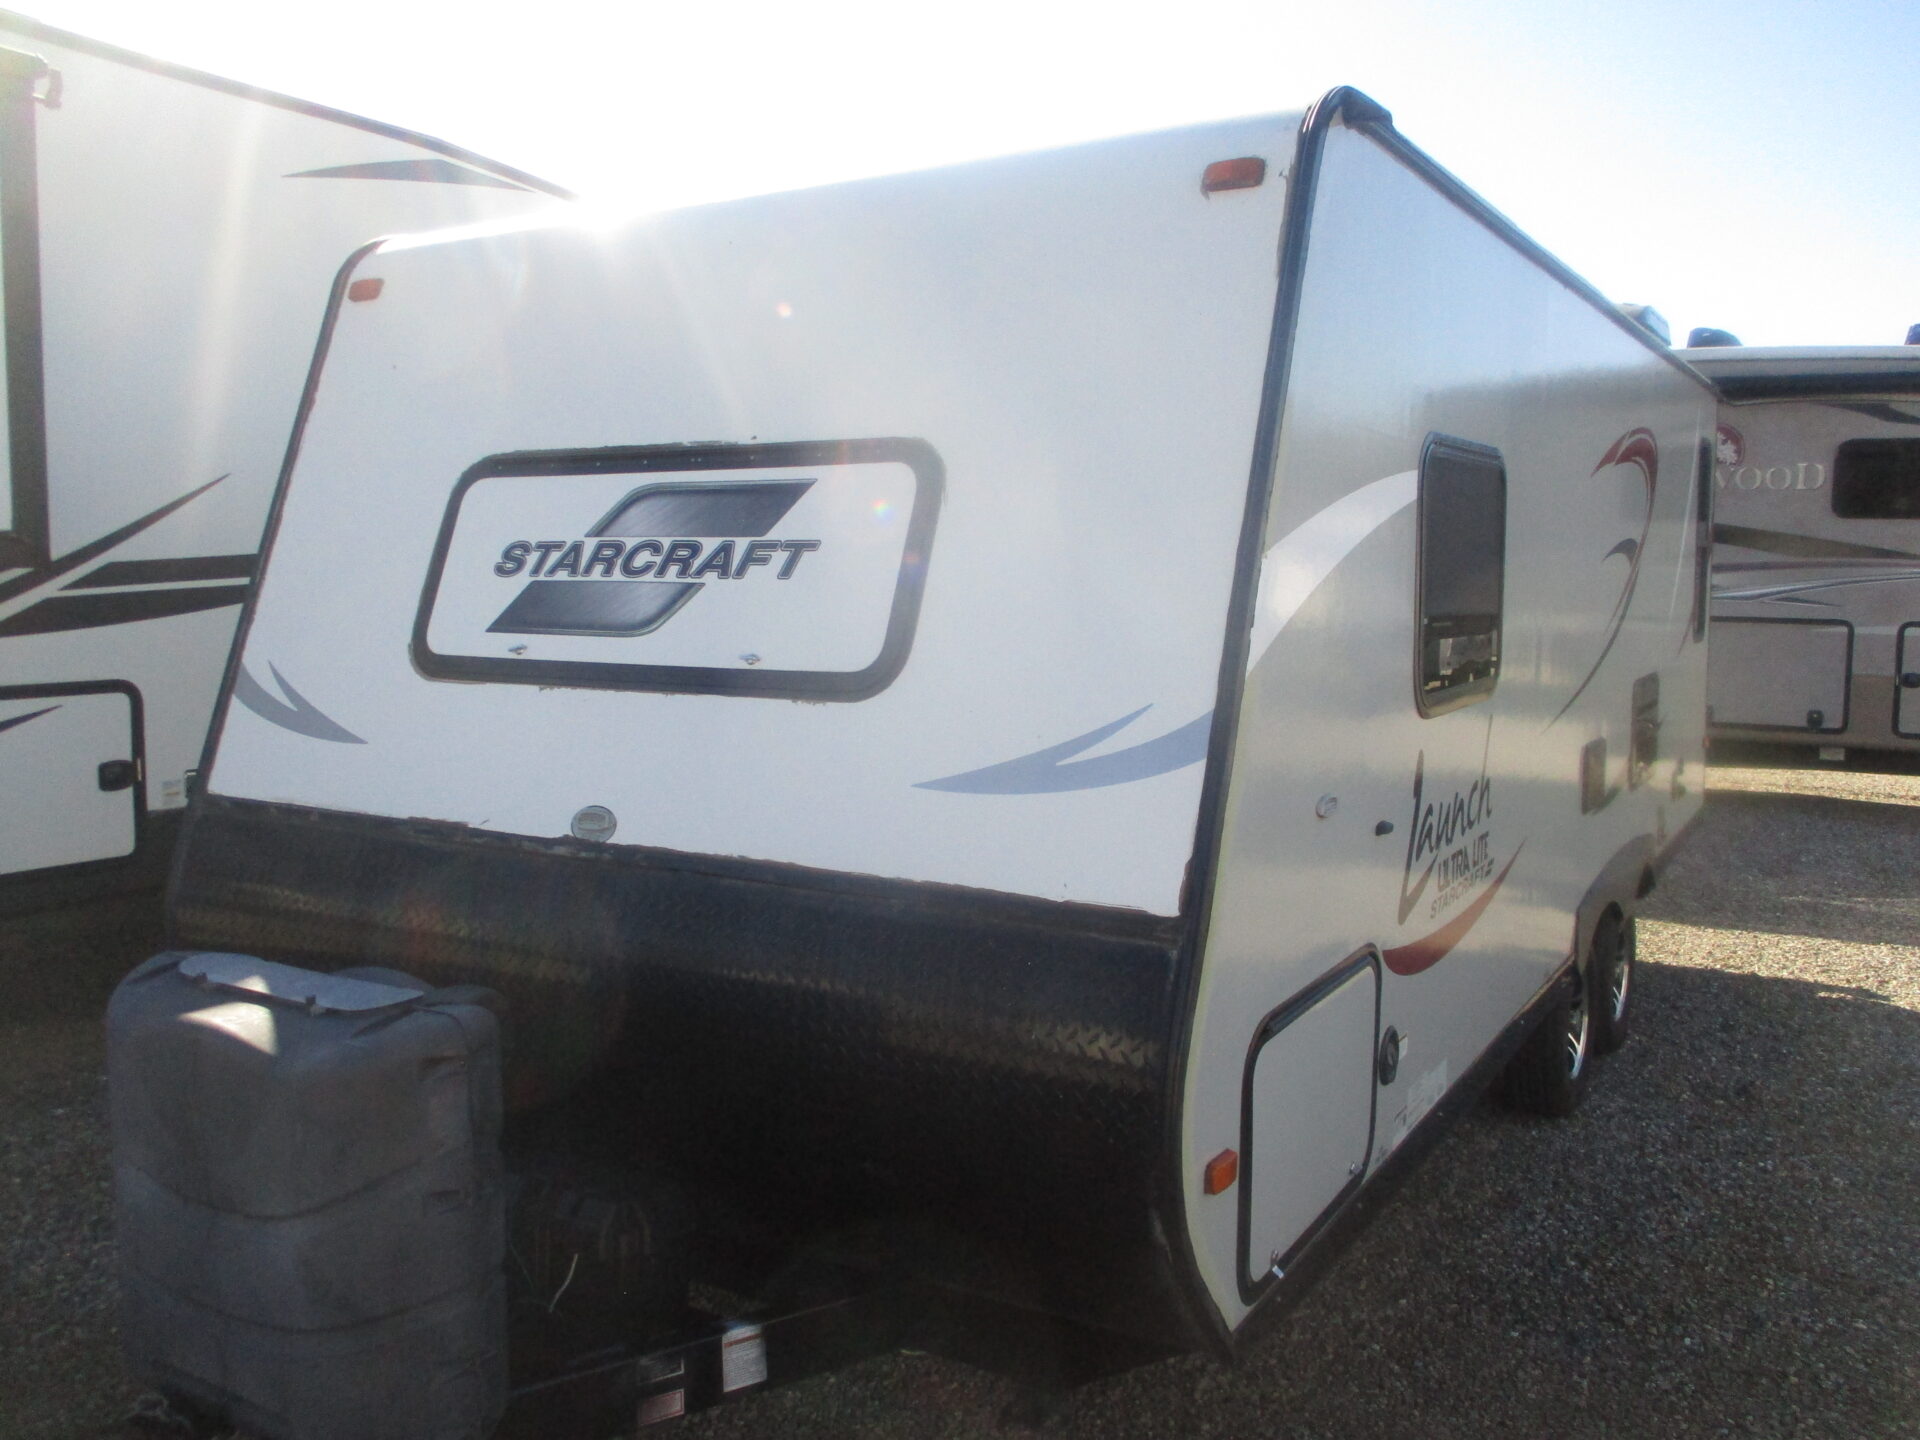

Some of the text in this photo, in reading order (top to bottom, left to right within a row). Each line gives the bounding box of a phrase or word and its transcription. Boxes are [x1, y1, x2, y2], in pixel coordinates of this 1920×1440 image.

[493, 539, 821, 580] STARCRAFT
[1437, 830, 1489, 892] ULTRA LITE
